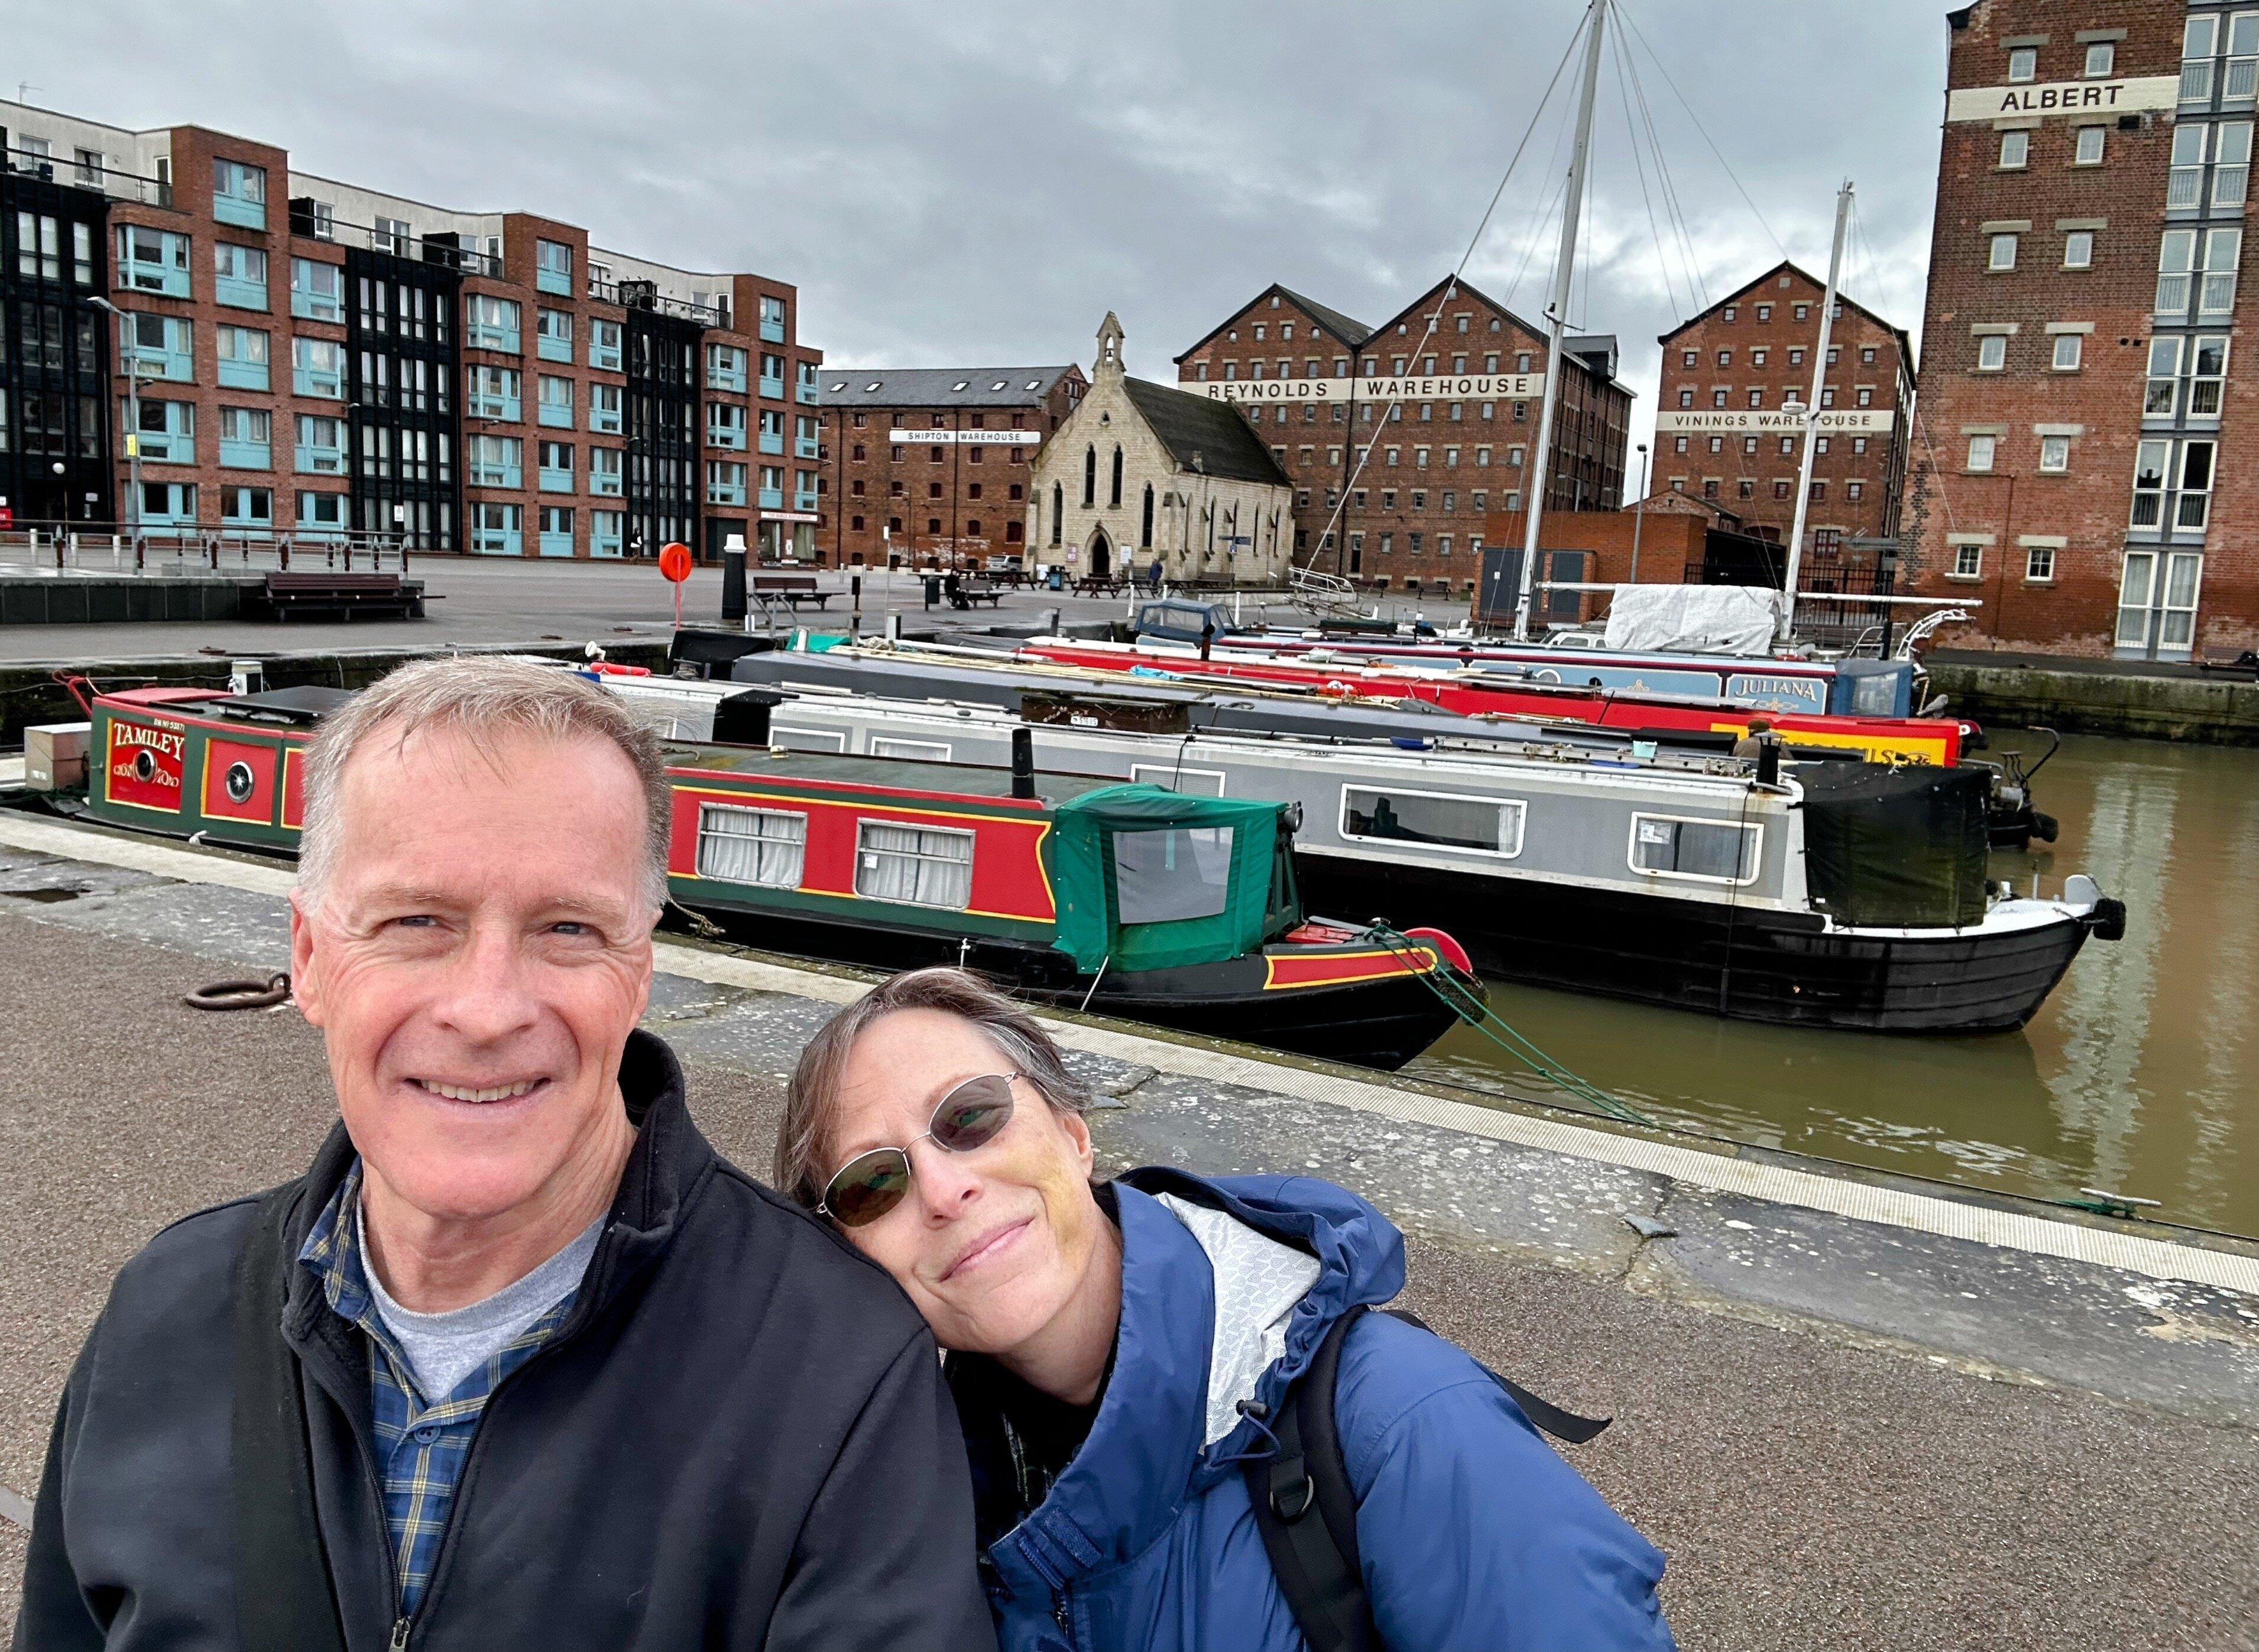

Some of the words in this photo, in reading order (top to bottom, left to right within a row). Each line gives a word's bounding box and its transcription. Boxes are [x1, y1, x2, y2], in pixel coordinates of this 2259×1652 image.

[2000, 85, 2124, 111] ALBERT
[1208, 382, 1328, 398] REYNOLDS
[1367, 378, 1527, 395] WAREHOUSE
[1675, 415, 1747, 426] VININGS
[1759, 415, 1871, 426] WAREOUSE
[960, 433, 1020, 441] WAREHOUSE
[1734, 679, 1817, 702] JULIANA
[114, 722, 184, 761] TAMILEY
